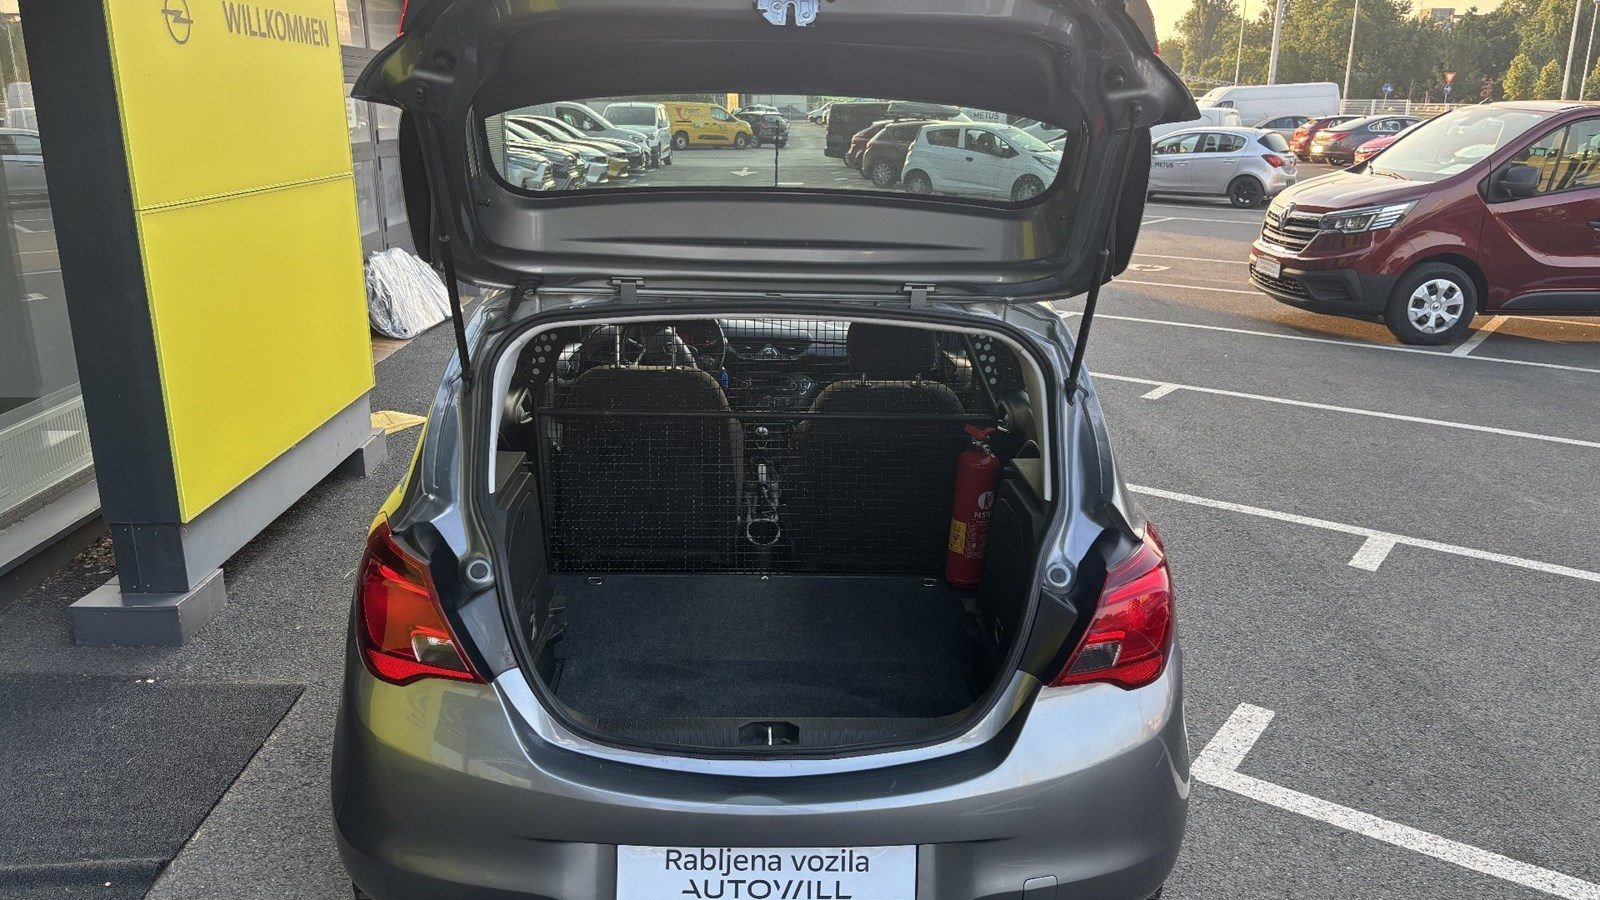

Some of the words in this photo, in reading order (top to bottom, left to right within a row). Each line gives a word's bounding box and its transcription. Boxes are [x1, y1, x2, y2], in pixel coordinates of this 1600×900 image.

[221, 0, 329, 47] WILLKOMMEN
[973, 111, 999, 120] METUS
[665, 848, 782, 876] Rabljena
[790, 848, 870, 872] vozila
[681, 879, 853, 900] AUTOWILL
